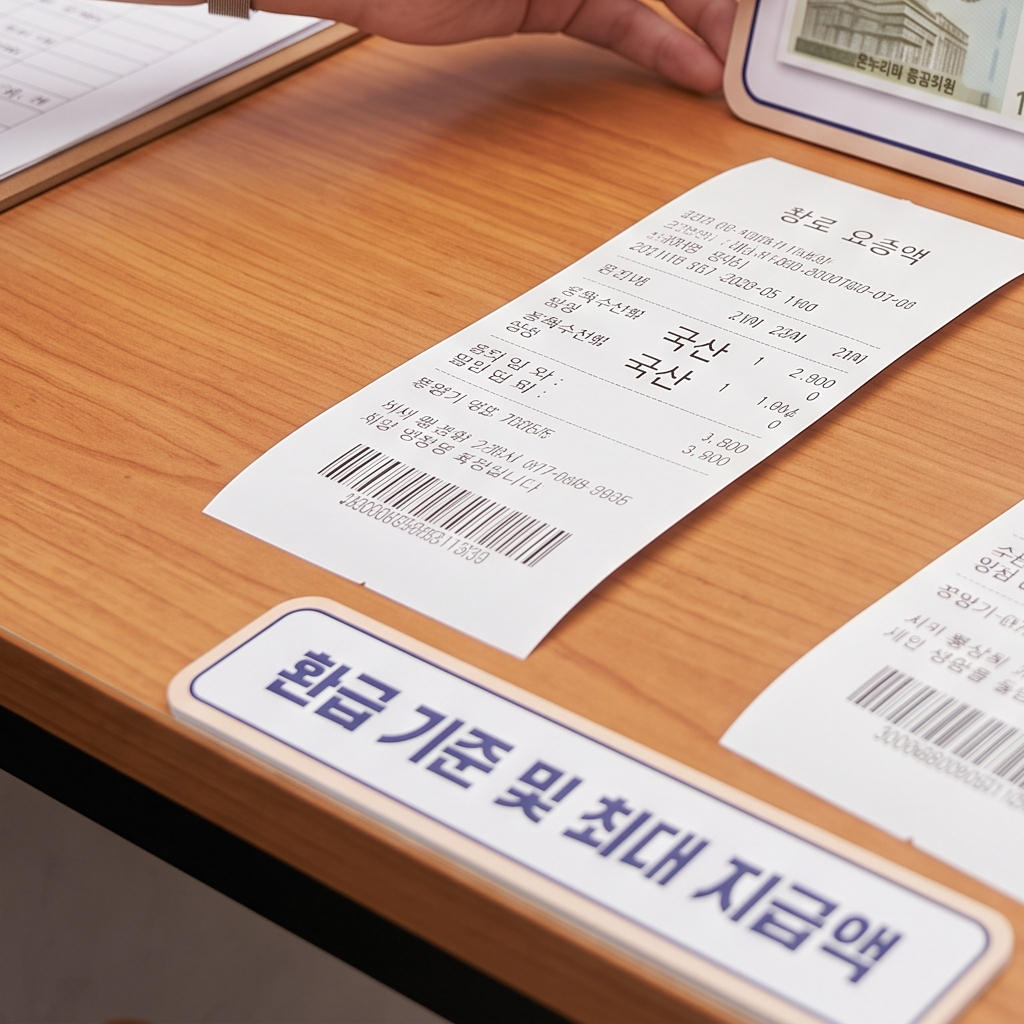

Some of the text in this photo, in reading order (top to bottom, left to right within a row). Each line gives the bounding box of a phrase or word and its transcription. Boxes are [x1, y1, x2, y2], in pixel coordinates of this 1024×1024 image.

[663, 326, 731, 363] 국산
[625, 353, 694, 391] 국산
[806, 391, 820, 402] 0
[767, 419, 782, 430] 0
[265, 649, 904, 985] 환급 기준 및 최대 지급액
